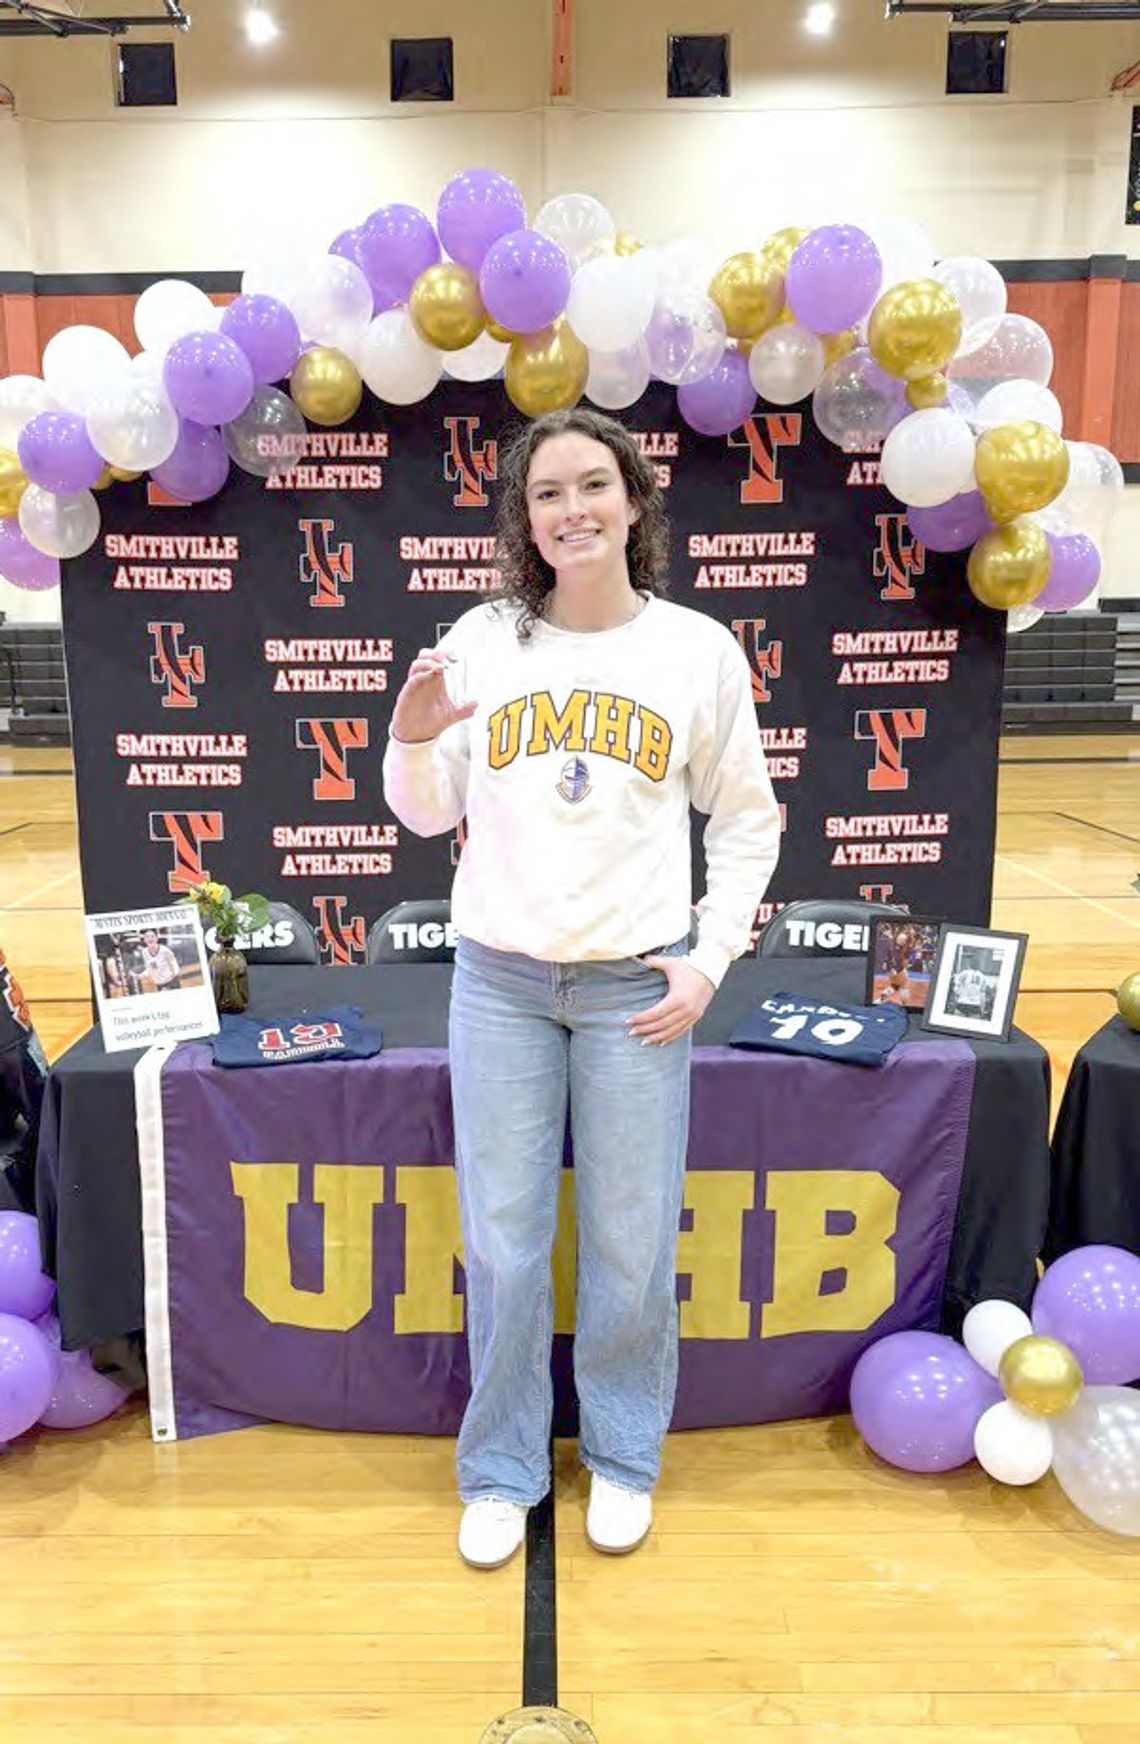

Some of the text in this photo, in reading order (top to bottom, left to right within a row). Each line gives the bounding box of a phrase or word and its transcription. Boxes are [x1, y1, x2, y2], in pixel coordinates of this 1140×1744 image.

[257, 433, 389, 457] SMITHVILLE
[265, 465, 383, 490] ATHLETICS
[105, 535, 239, 560] SMITHVILLE
[399, 536, 498, 560] SMITHVI
[689, 532, 815, 558] SMITHVILLE
[114, 567, 232, 591] ATHLETICS
[407, 568, 501, 592] ATHLETI
[695, 564, 806, 588] ATHLETICS
[265, 638, 393, 662] SMITHVILLE
[832, 629, 958, 655] SMITHVILLE
[274, 669, 387, 693] ATHLETICS
[837, 659, 949, 684] ATHLETICS
[117, 733, 248, 758] SMITHVILLE
[488, 689, 673, 783] UMHB
[126, 763, 242, 787] ATHLETICS
[273, 824, 398, 849] SMITHVILLE
[825, 813, 949, 838] SMITHVILLE
[281, 853, 392, 876] ATHLETICS
[831, 842, 941, 866] ATHLETICS
[388, 922, 460, 950] TIGE
[786, 920, 870, 952] TIGE
